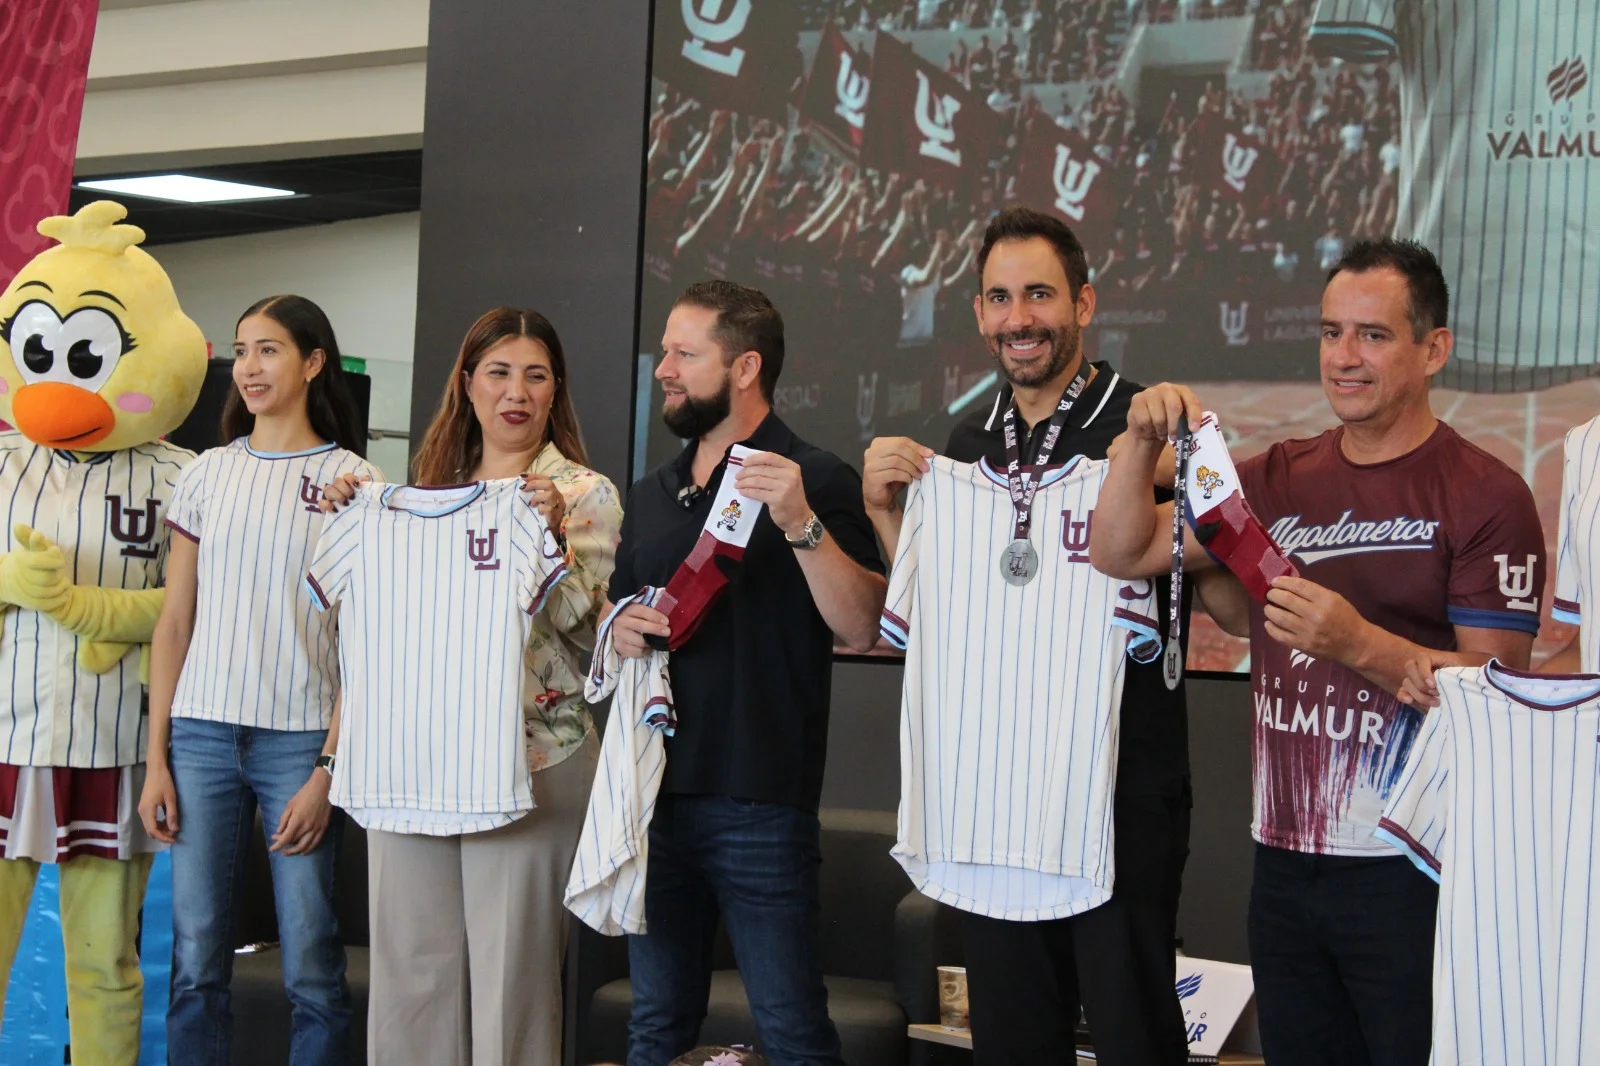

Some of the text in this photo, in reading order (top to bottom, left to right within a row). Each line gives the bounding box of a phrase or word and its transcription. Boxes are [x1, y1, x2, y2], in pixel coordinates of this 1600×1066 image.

[104, 495, 162, 559] UL
[466, 528, 500, 570] UL
[1493, 553, 1538, 612] UL
[1261, 673, 1370, 702] GRUPO
[1254, 691, 1384, 746] VALMUR
